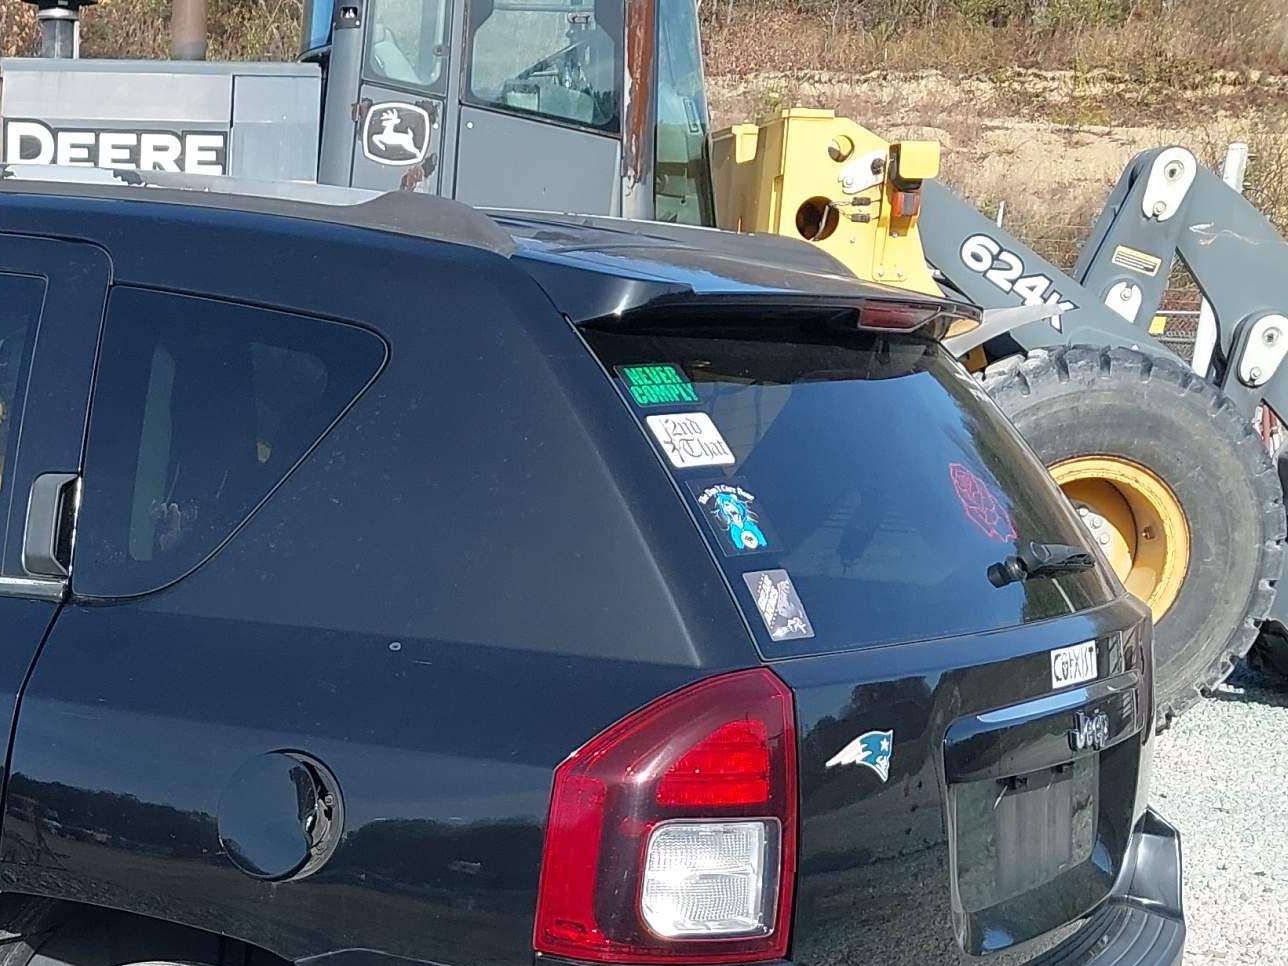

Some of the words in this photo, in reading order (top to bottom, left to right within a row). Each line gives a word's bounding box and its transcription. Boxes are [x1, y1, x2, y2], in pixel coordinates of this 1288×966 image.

[6, 120, 225, 176] DEERE
[959, 233, 1080, 334] 624K
[623, 366, 683, 387] NEVER
[630, 382, 699, 404] COMPLY
[671, 418, 703, 436] 2nd
[678, 438, 729, 460] That
[1053, 645, 1095, 682] COEXIST
[1065, 707, 1110, 751] Jeep
